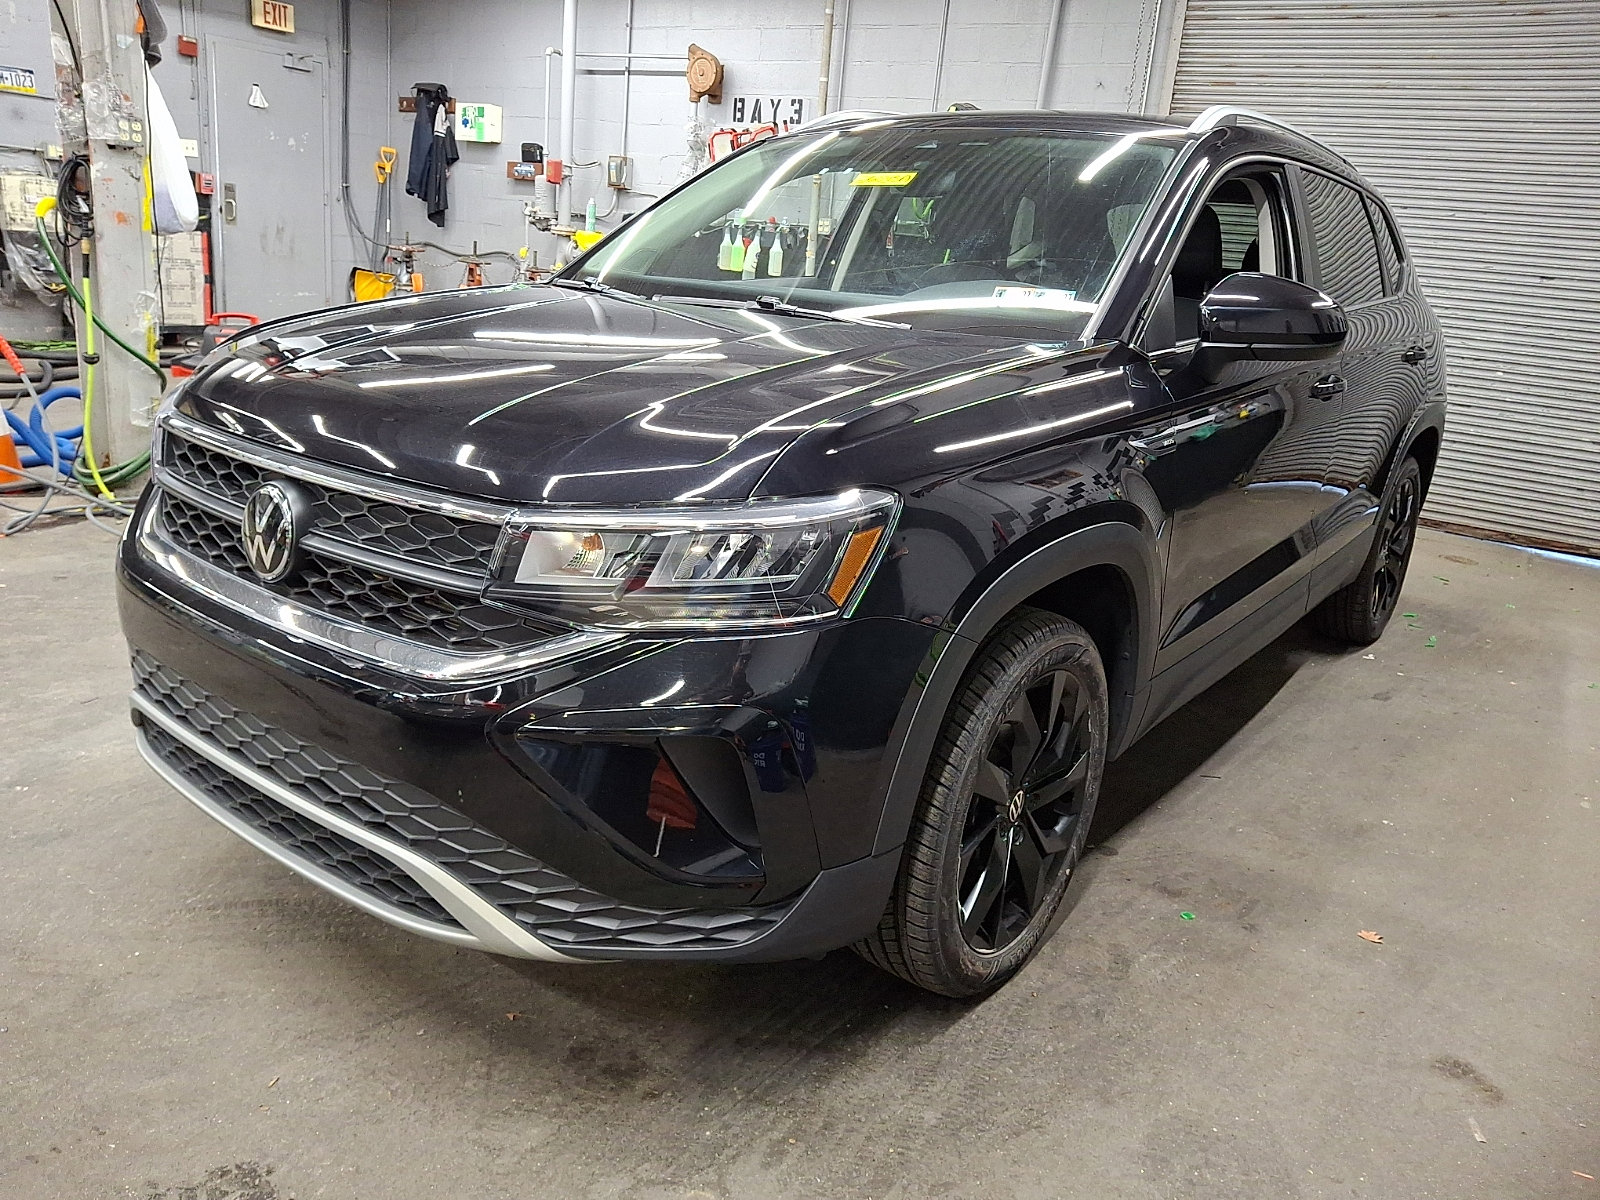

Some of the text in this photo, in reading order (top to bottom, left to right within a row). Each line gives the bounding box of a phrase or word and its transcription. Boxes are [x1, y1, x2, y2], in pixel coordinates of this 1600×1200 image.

[263, 1, 288, 28] EXIT
[733, 97, 803, 124] BAY 3
